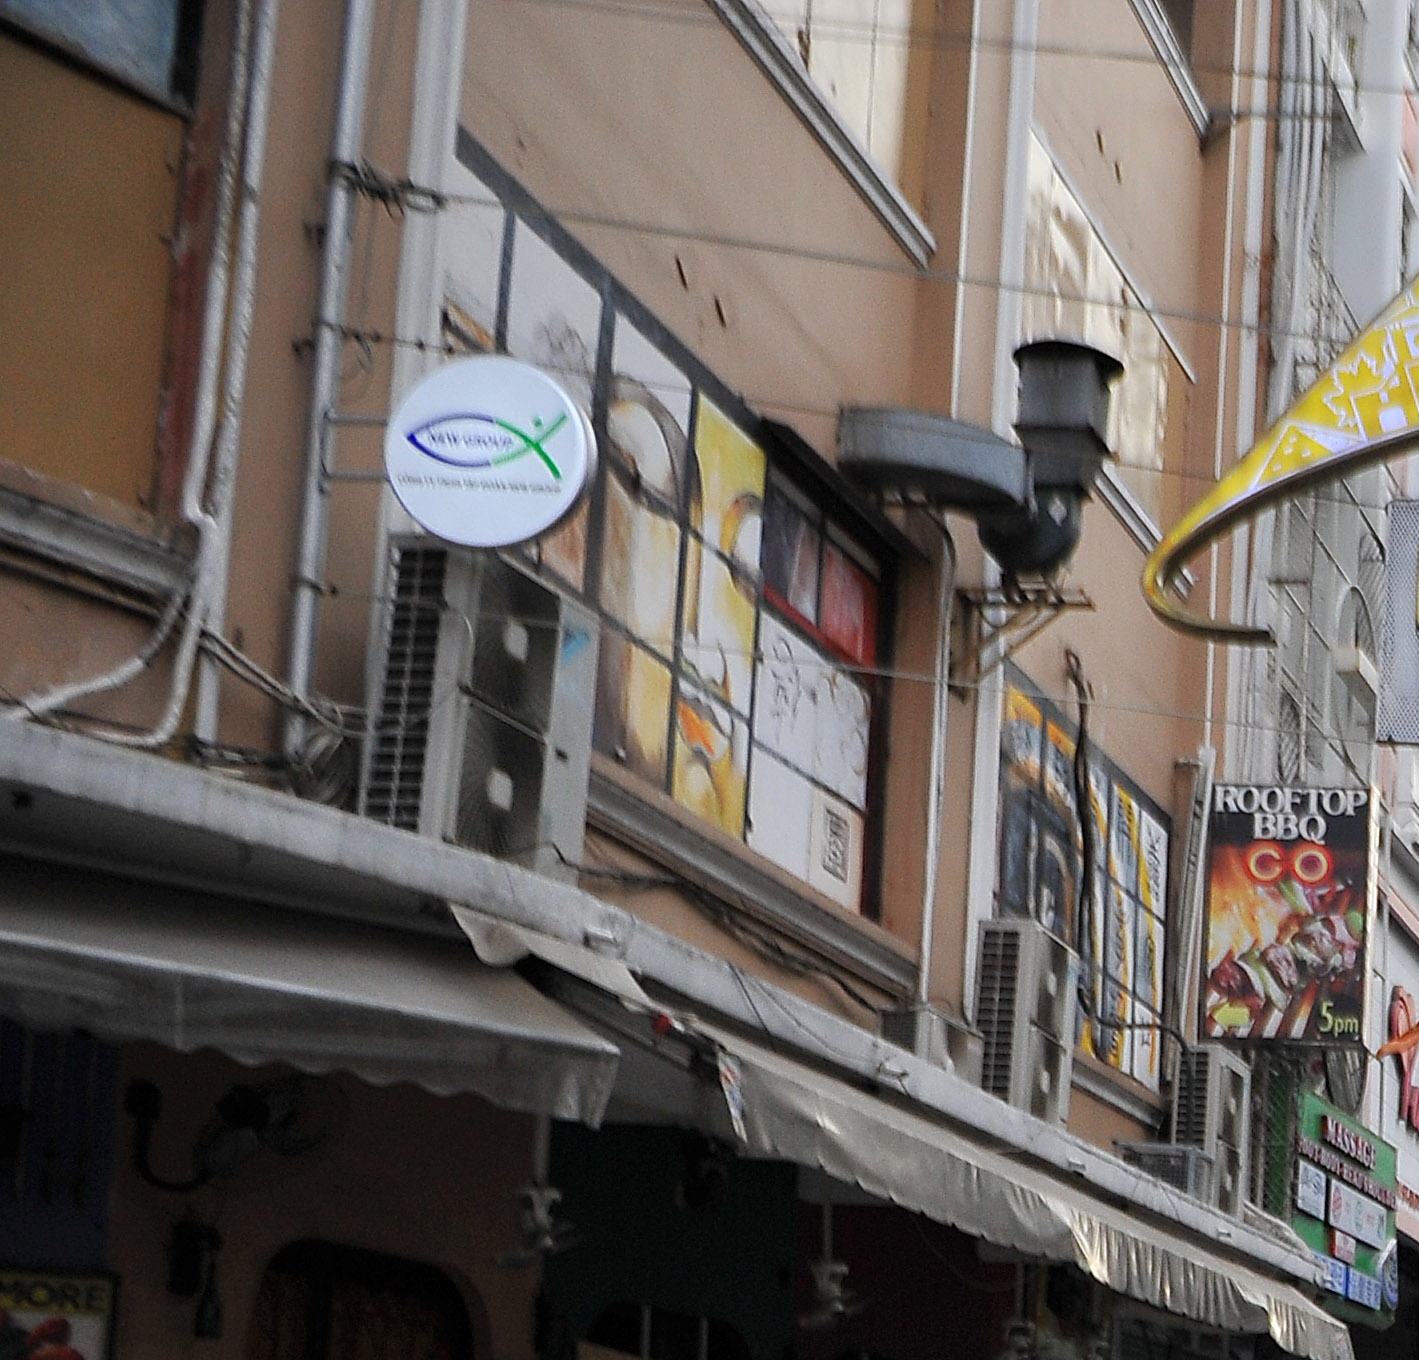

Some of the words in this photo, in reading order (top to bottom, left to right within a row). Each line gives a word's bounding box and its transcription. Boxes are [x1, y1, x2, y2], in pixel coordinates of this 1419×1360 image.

[1214, 785, 1369, 817] ROOFTOP
[1253, 813, 1328, 845] BBQ
[1319, 1000, 1359, 1035] 5pm
[1321, 1115, 1377, 1170] MASSAGE
